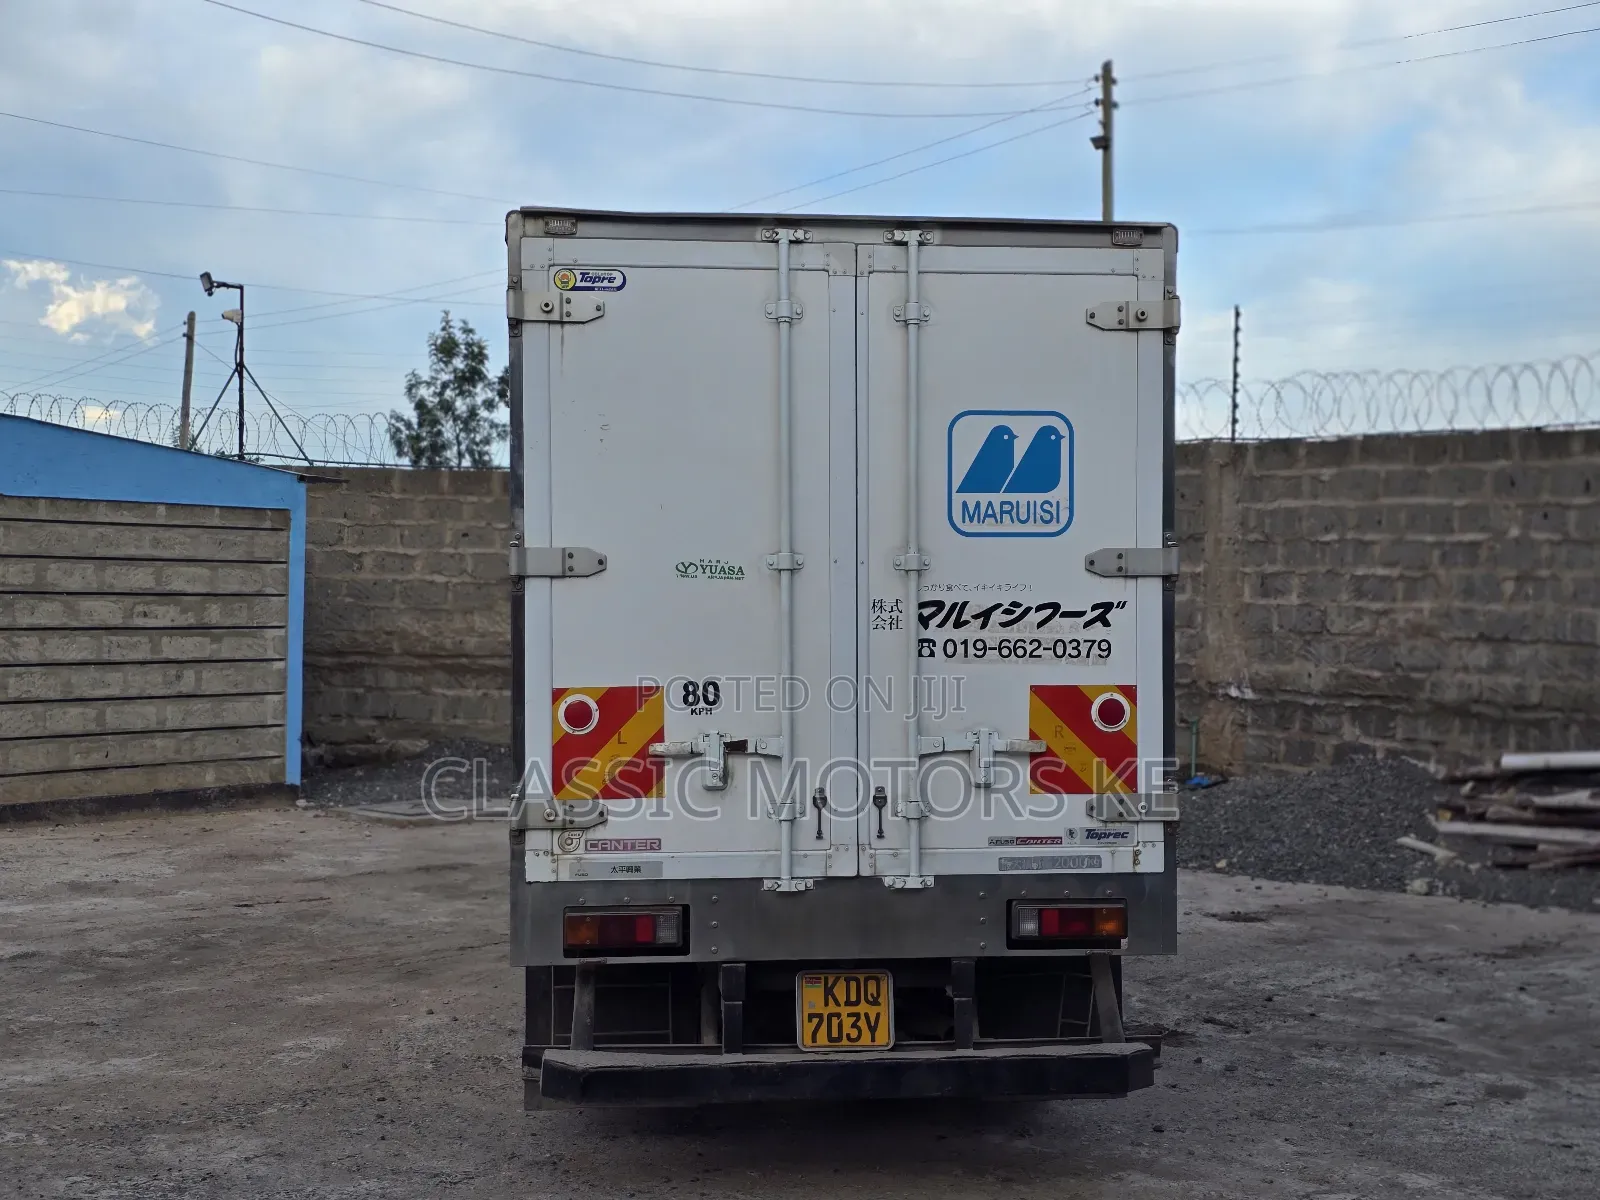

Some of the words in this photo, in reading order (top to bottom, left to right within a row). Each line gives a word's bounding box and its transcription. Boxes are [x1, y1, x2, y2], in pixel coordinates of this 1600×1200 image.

[580, 272, 616, 284] Topre
[961, 500, 1061, 525] MARUISI
[700, 564, 745, 576] YUASA
[871, 599, 903, 614] 株式
[871, 615, 903, 631] 会社
[918, 600, 1128, 631] マルイシフーズ
[942, 638, 1112, 659] 019-662-0379
[682, 680, 721, 707] 80
[690, 707, 713, 716] KPH
[617, 730, 628, 745] L
[1054, 724, 1065, 739] R
[1085, 828, 1130, 841] Toprec
[586, 840, 661, 851] CANTER
[823, 975, 882, 1008] KDQ
[807, 1011, 881, 1044] 703Y
